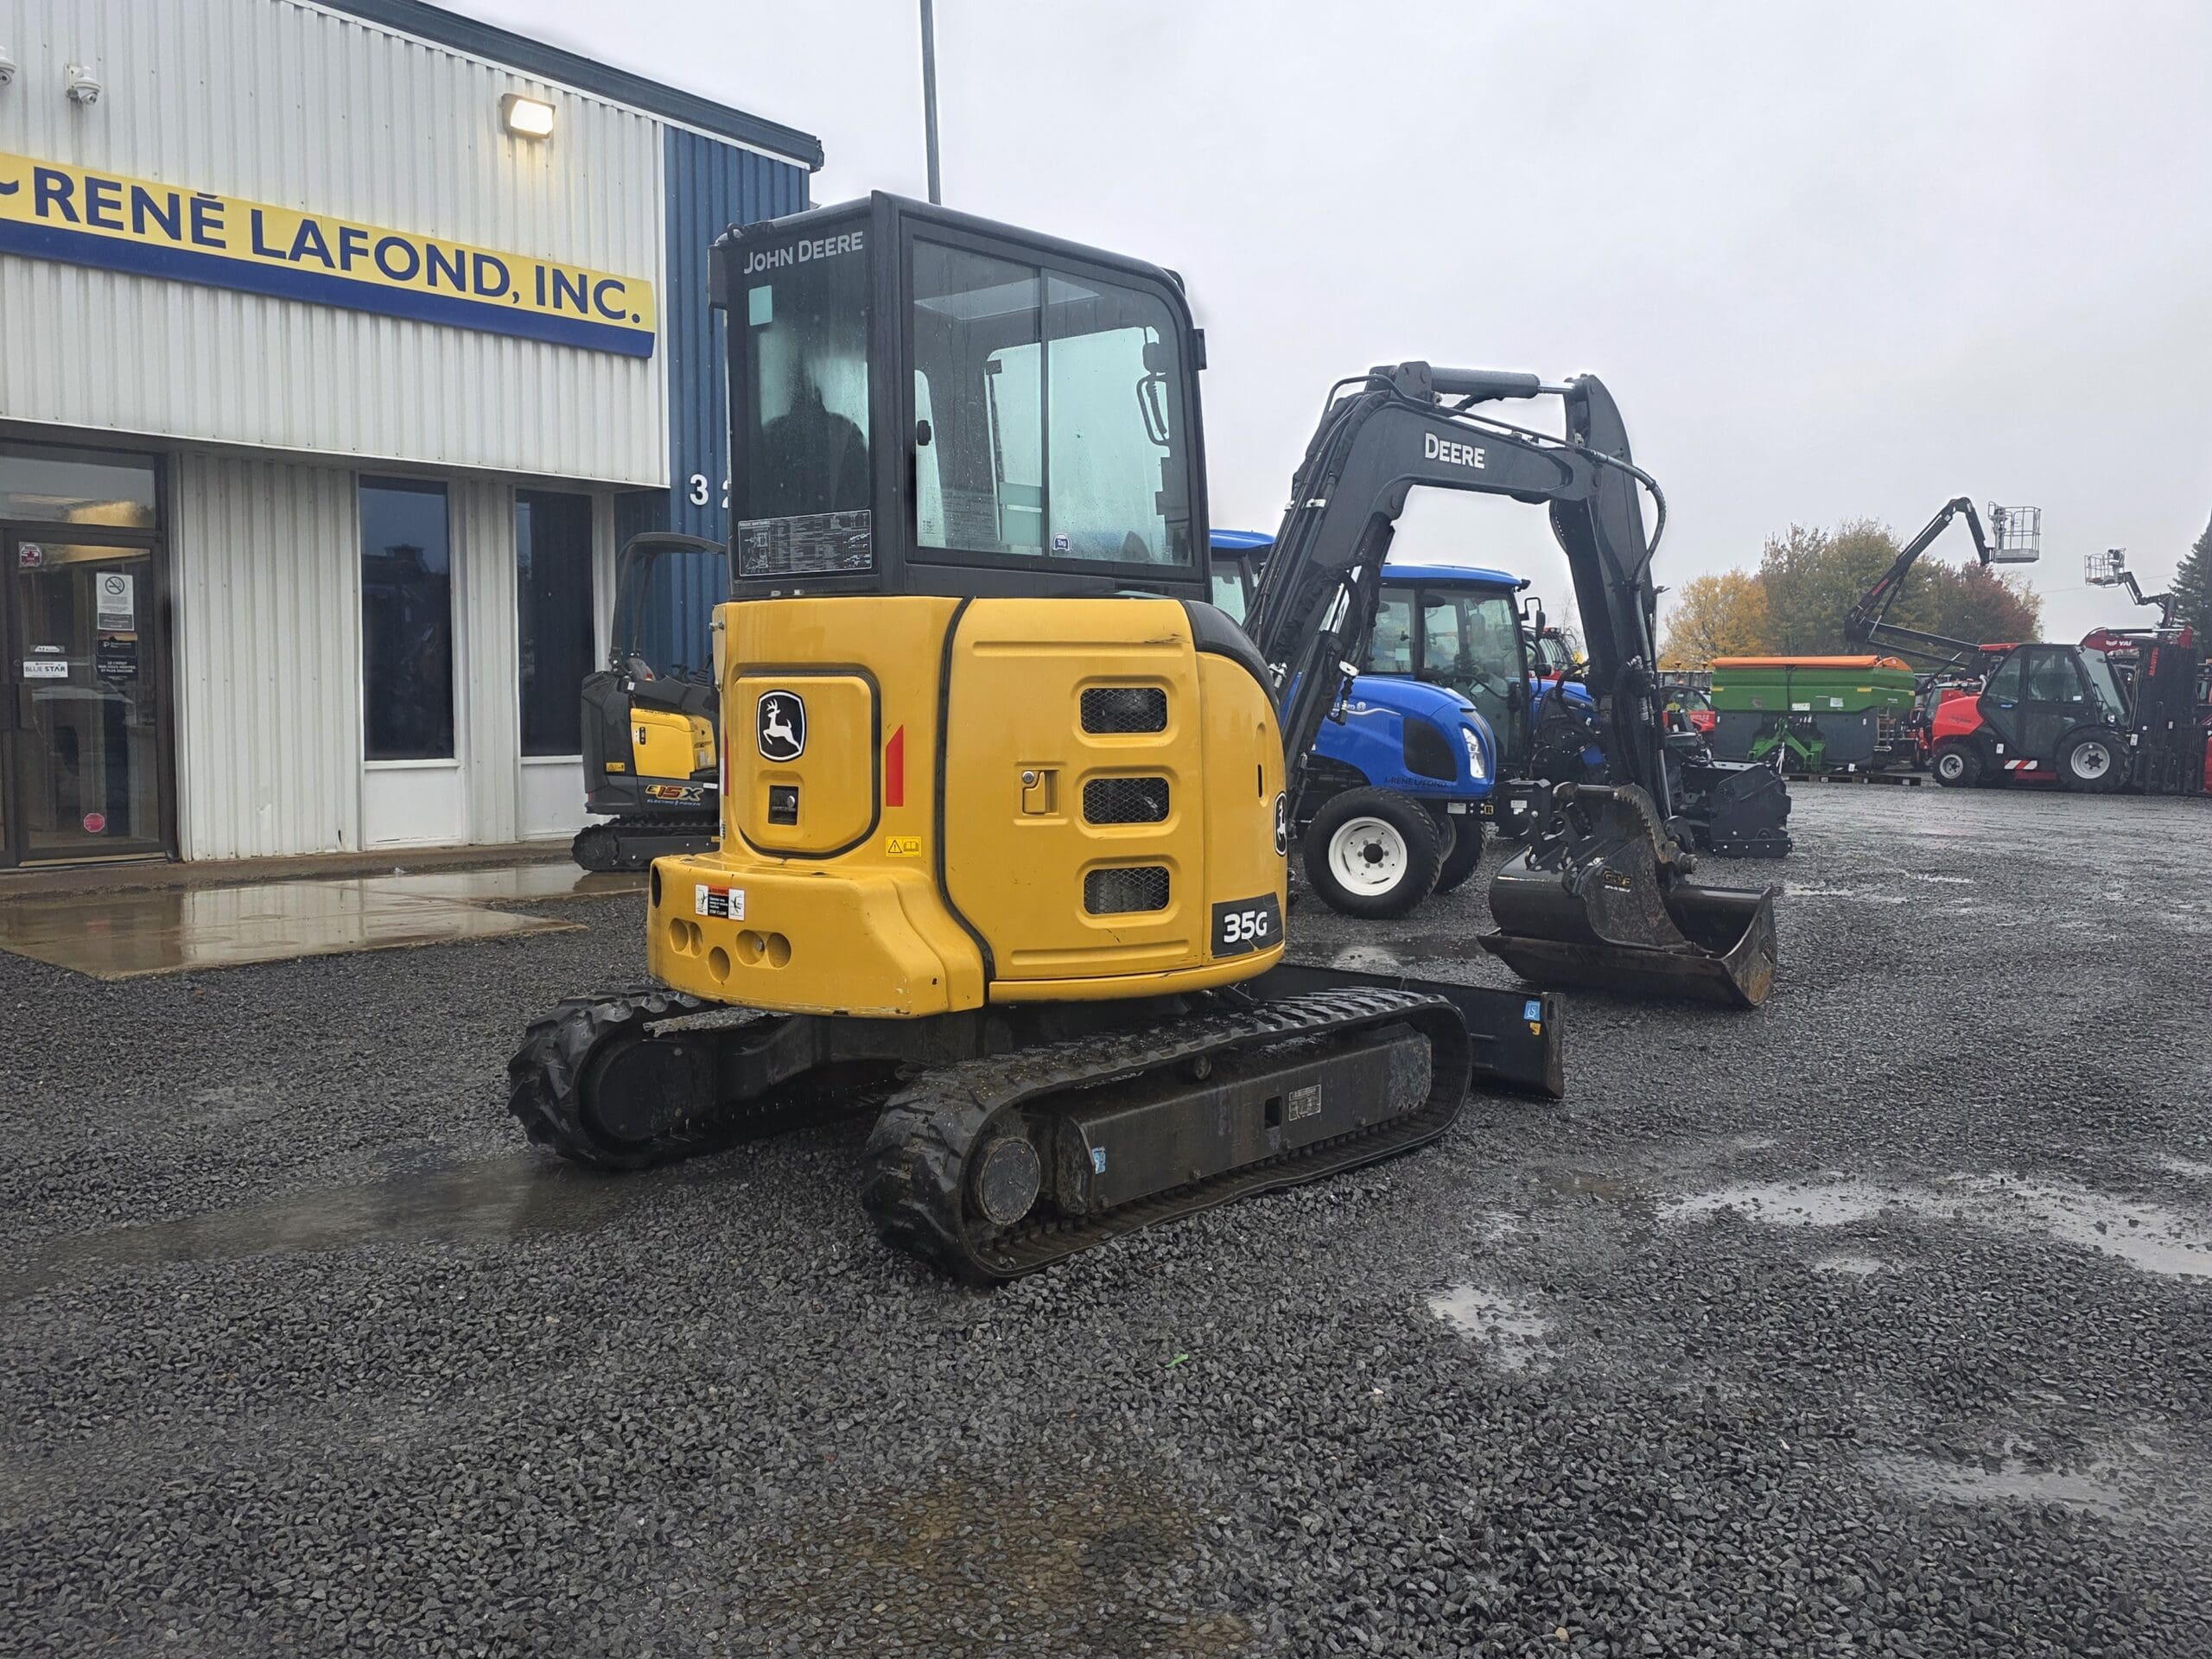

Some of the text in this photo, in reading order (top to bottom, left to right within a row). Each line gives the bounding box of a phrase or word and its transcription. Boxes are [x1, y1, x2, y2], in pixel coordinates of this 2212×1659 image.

[251, 208, 520, 303] LAFOND,
[535, 264, 640, 323] INC.
[743, 231, 863, 274] JOHN DEERE
[1425, 432, 1485, 469] DEERE
[45, 664, 66, 672] STAR
[645, 784, 704, 802] E15X
[1224, 911, 1268, 944] 35G
